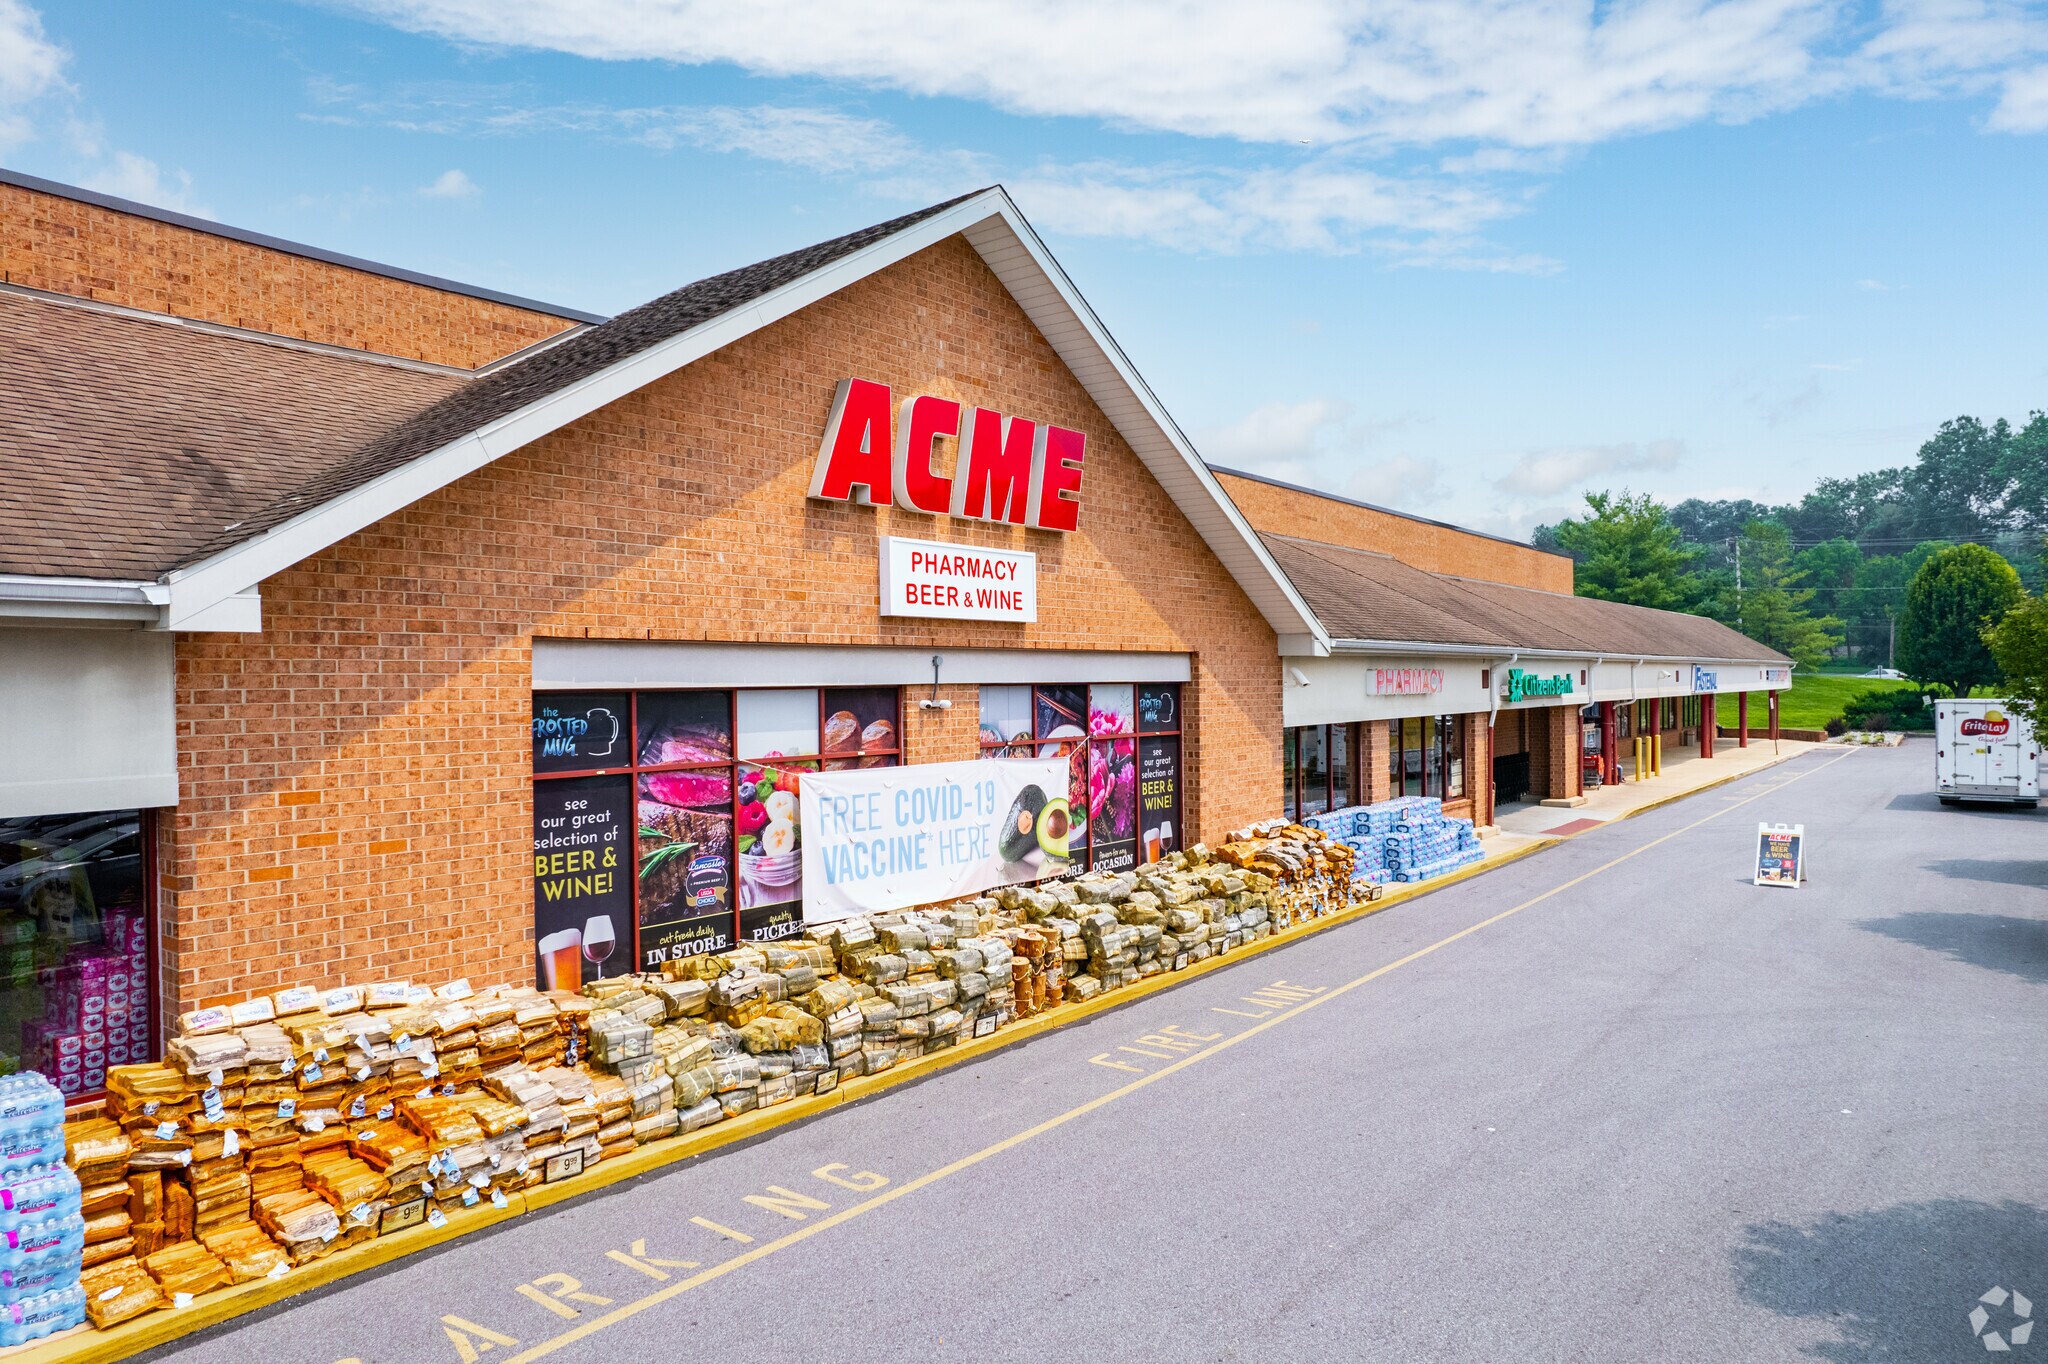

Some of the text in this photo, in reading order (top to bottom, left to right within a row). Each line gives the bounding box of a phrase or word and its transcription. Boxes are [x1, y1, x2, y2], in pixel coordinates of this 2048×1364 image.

[814, 377, 1087, 532] ACME
[911, 551, 1018, 581] PHARMACY
[905, 583, 1023, 611] BEER & WINE
[1375, 668, 1445, 695] PHARMACY
[1523, 674, 1574, 696] Citizens Bank
[542, 706, 559, 717] the
[532, 717, 588, 738] FROSTED
[1964, 721, 2006, 734] Frito Lay
[542, 736, 576, 757] MUG
[1152, 749, 1163, 757] see
[1144, 756, 1171, 767] our great
[1141, 765, 1174, 780] selection of
[1142, 778, 1174, 796] BEER &
[564, 799, 588, 811] see
[818, 780, 995, 837] FREE COVID-19
[1144, 795, 1172, 811] WINE!
[541, 809, 611, 829] our great
[534, 824, 619, 850] selection of
[939, 823, 991, 867] HERE
[535, 846, 618, 877] BEER &
[689, 858, 726, 871] Lancaster
[1092, 854, 1134, 872] OCCASION
[541, 871, 614, 902] WINE!
[769, 910, 793, 926] quality
[659, 925, 715, 945] cut fresh daily
[646, 934, 727, 966] IN STORE
[1088, 980, 1328, 1073] FIRE LANE
[331, 1163, 890, 1364] ARKING
